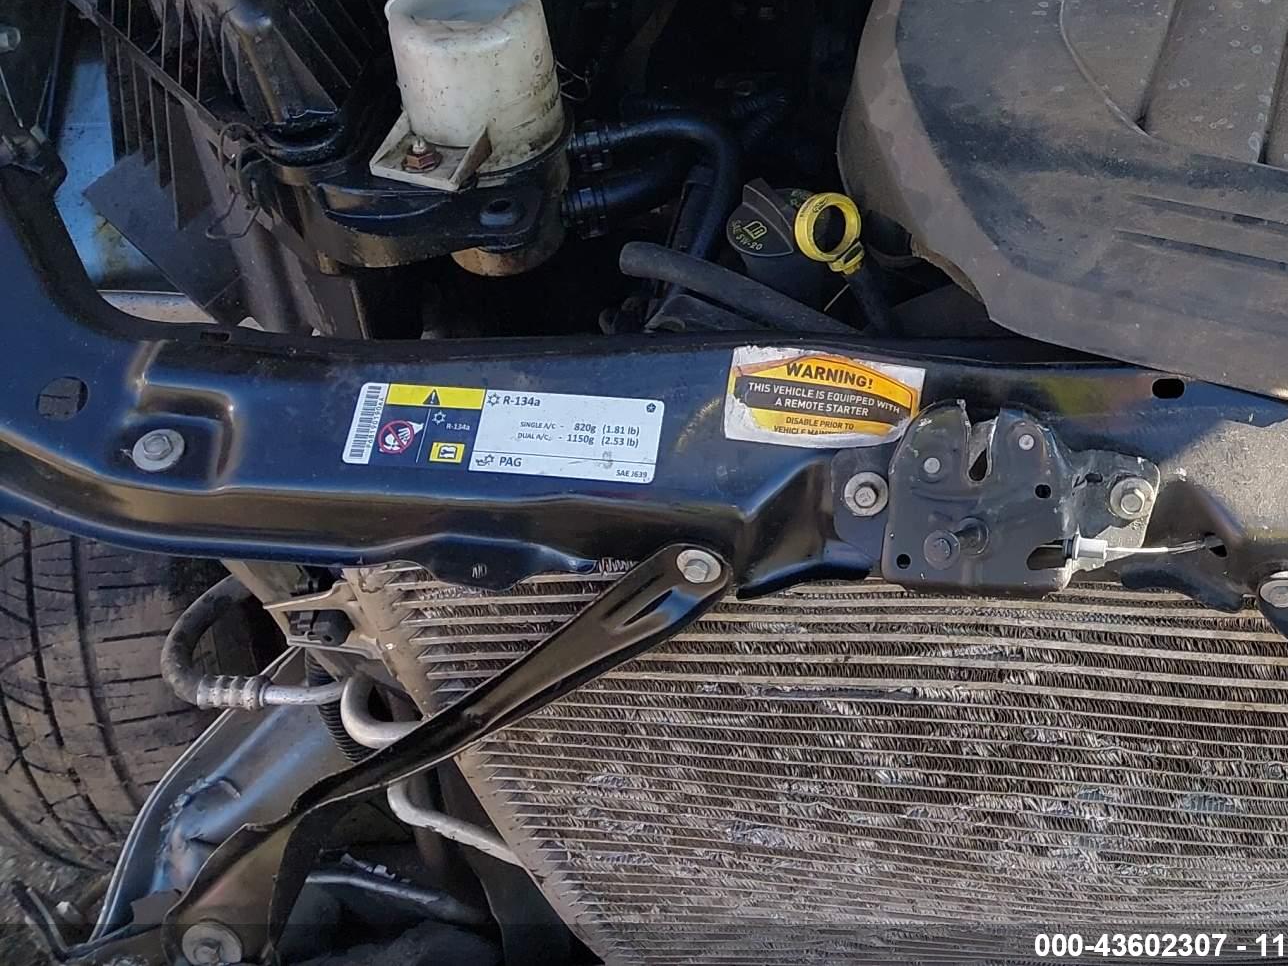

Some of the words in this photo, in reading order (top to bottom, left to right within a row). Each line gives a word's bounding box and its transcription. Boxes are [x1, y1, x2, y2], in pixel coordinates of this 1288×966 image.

[785, 362, 873, 389] WARNING!
[503, 395, 541, 407] R-134a
[748, 382, 771, 393] THIS
[773, 385, 815, 398] VEHICLE
[816, 390, 826, 399] IS
[827, 392, 875, 406] EQUIPPED
[876, 400, 900, 414] WITH
[774, 398, 782, 406] A
[784, 398, 824, 411] REMOTE
[826, 402, 869, 416] STARTER
[446, 423, 471, 431] R-134a
[520, 421, 543, 429] SINGLE
[543, 422, 556, 430] A/C
[574, 423, 597, 434] 820g
[602, 424, 625, 435] (1.81
[627, 425, 640, 438] lb)
[786, 416, 818, 427] DISABLE
[819, 420, 843, 429] PRIOR
[517, 432, 536, 440] DUAL
[566, 434, 595, 446] 1150g
[601, 435, 625, 446] (2.53
[626, 437, 639, 449] lb)
[499, 456, 522, 467] PAG
[615, 469, 630, 477] SAE
